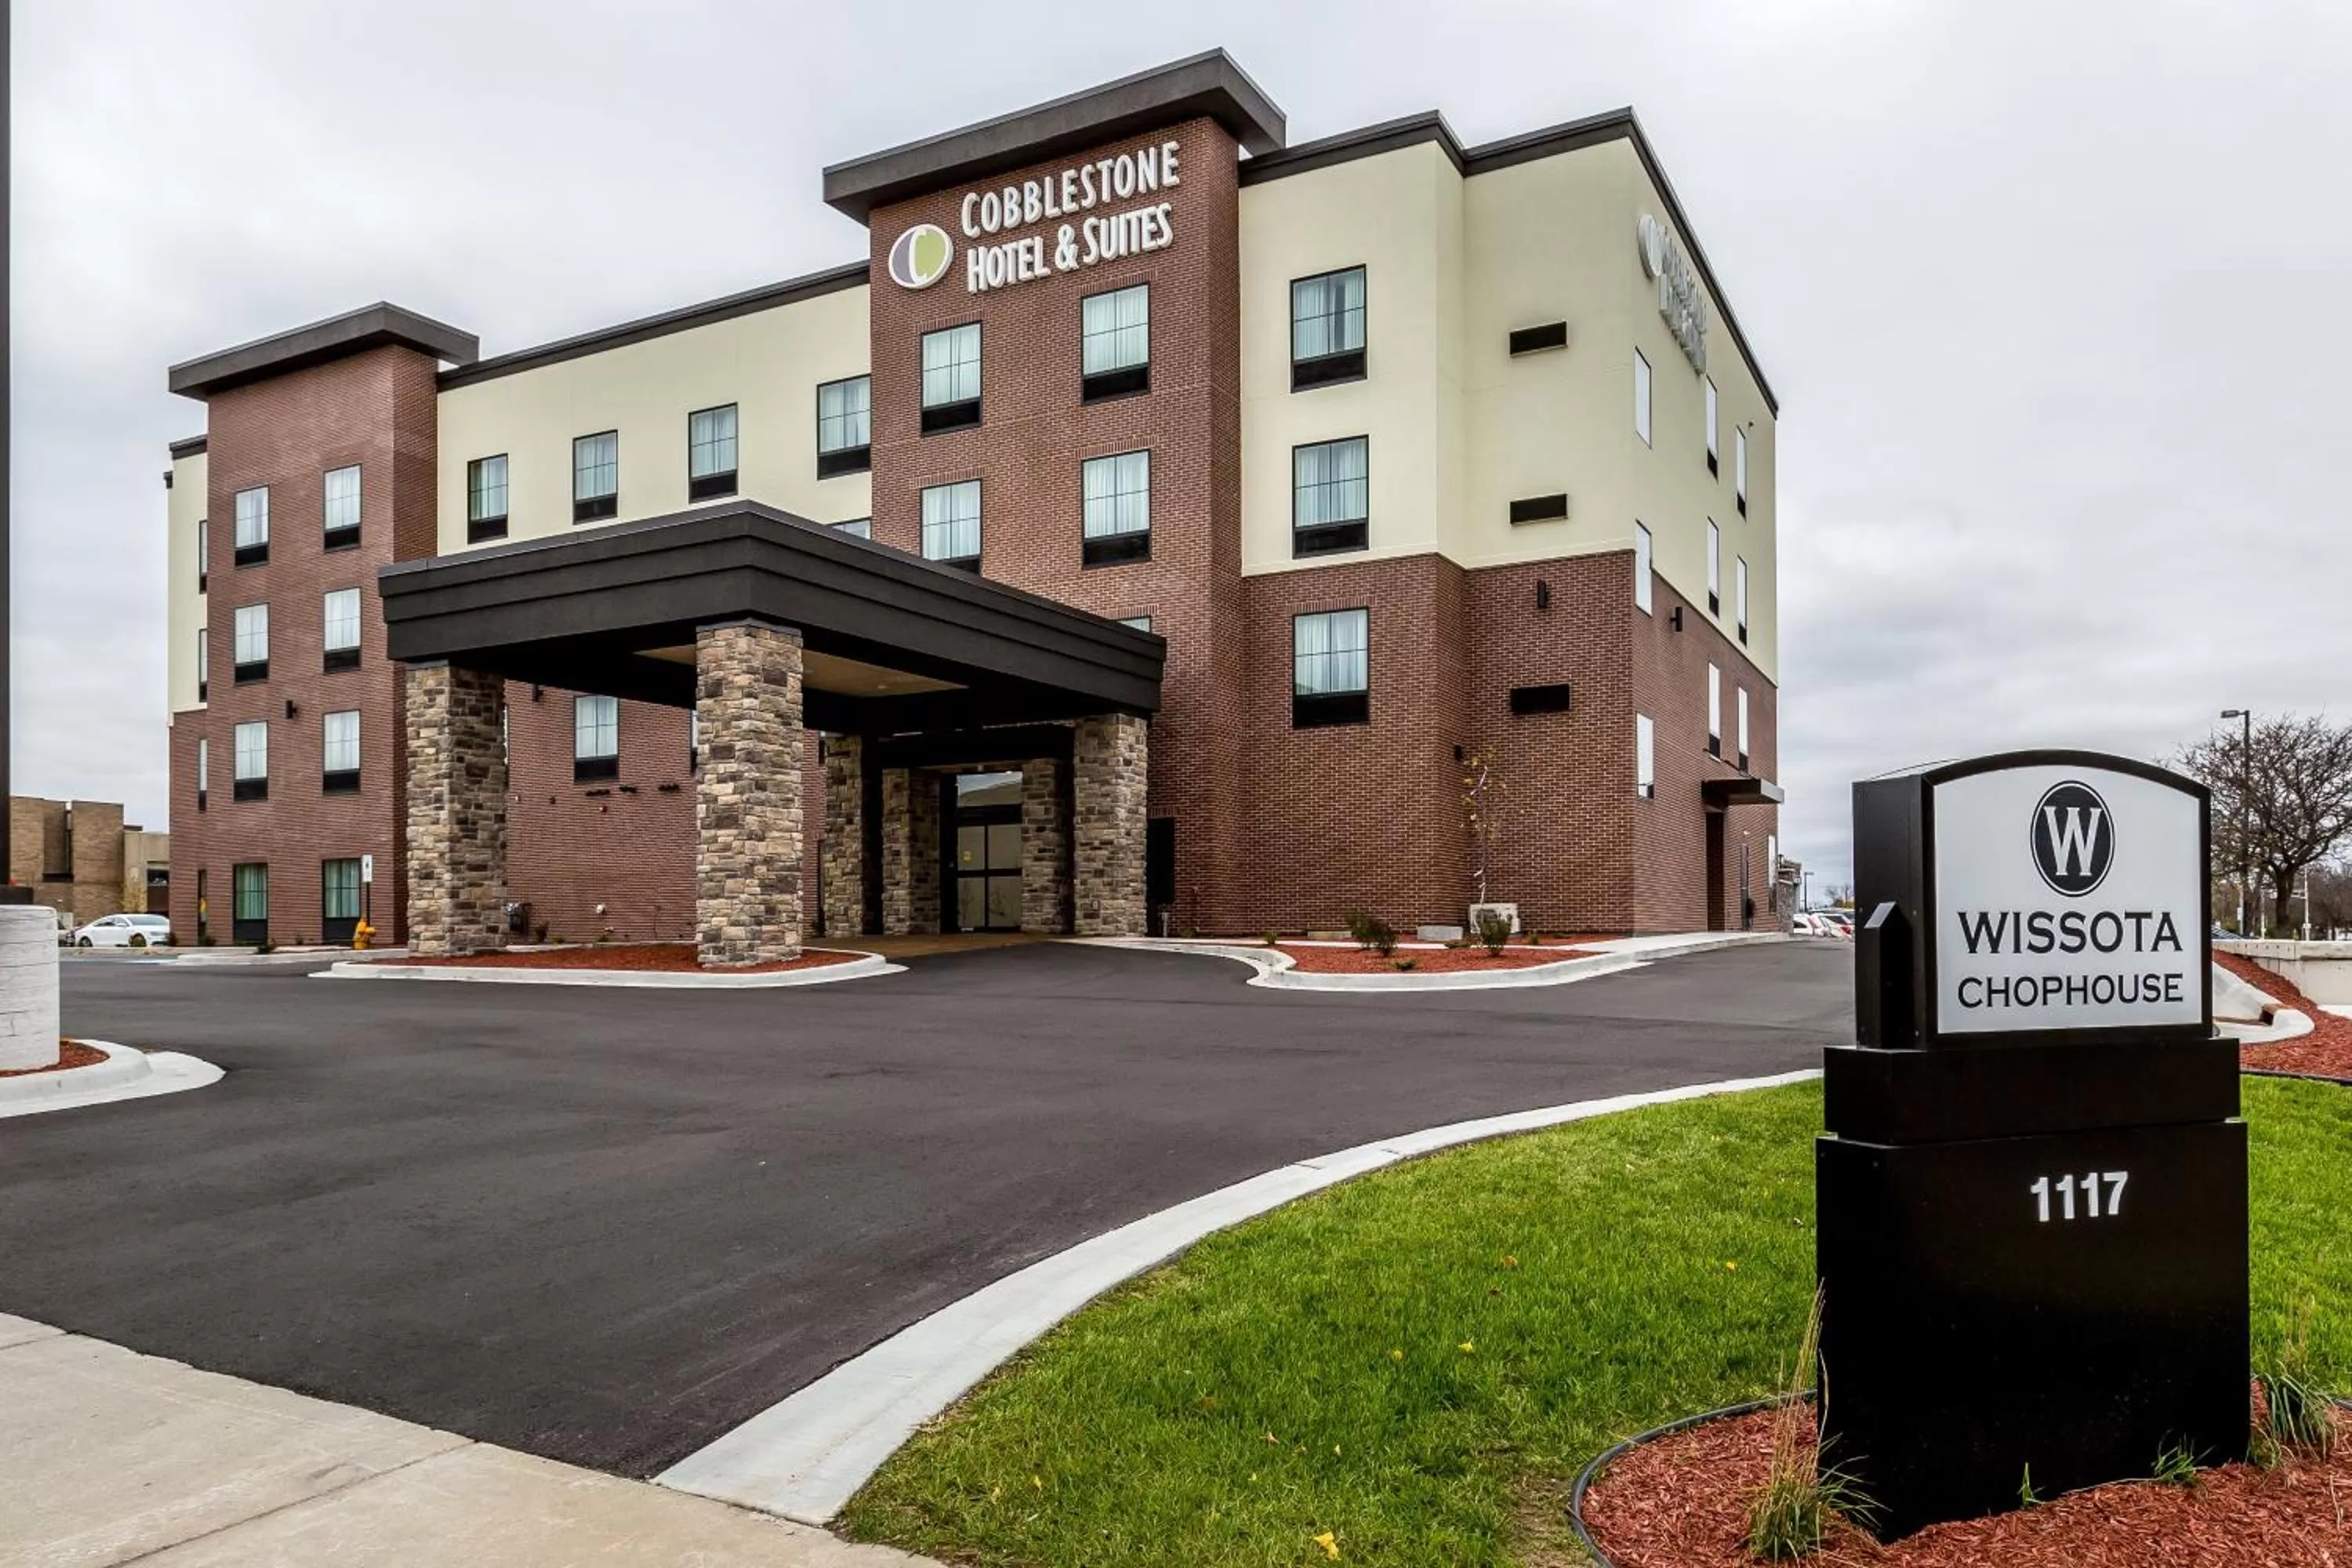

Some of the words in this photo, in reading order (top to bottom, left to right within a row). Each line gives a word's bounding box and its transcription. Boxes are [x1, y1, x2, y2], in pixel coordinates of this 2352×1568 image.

[961, 140, 1180, 237] COBBLESTONE
[967, 235, 1051, 293] HOTEL
[1054, 224, 1079, 271] &
[1083, 202, 1174, 265] SUITES
[2043, 805, 2102, 876] W
[1958, 911, 2183, 954] WISSOTA
[1959, 974, 2183, 1008] CHOPHOUSE
[2031, 1171, 2129, 1222] 1117
